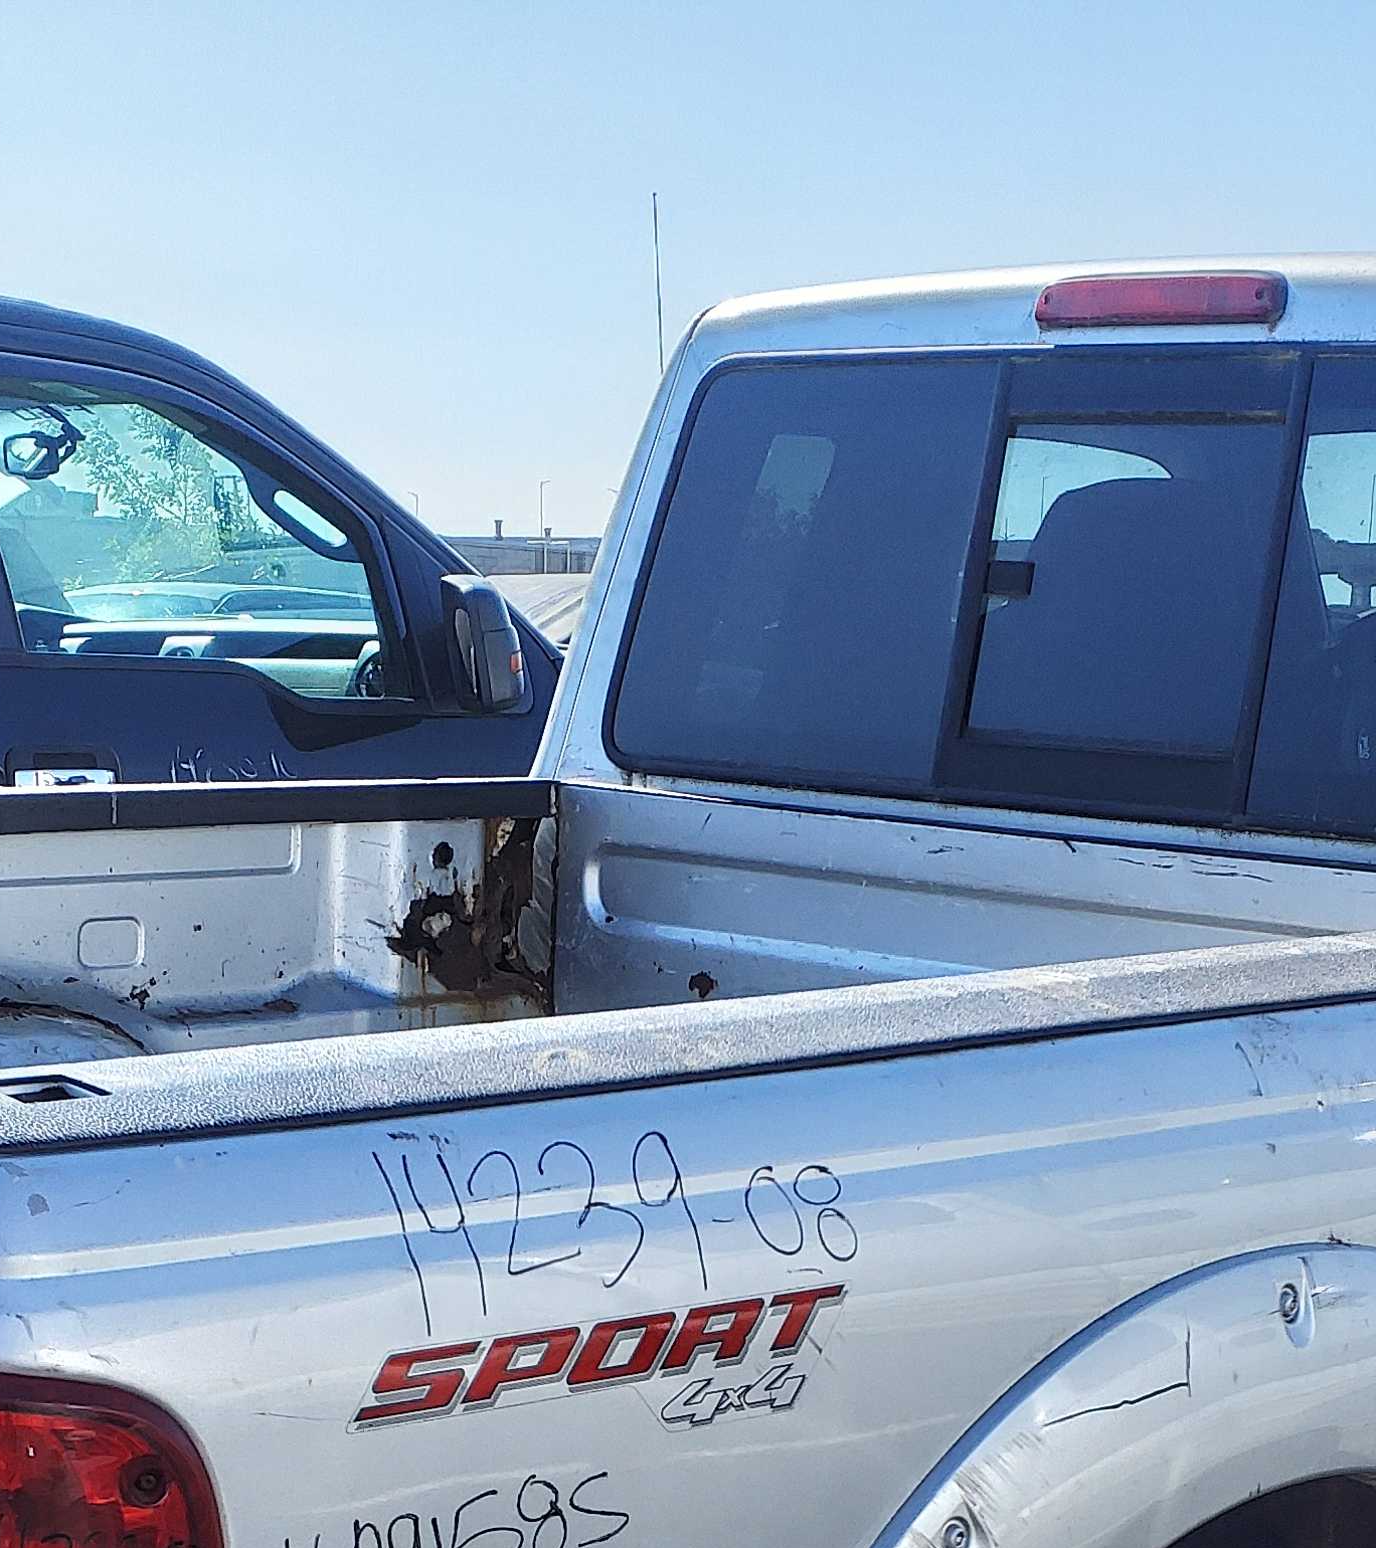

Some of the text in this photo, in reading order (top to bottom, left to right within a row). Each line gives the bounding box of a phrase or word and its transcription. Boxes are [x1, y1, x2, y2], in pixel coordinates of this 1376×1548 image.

[371, 1130, 859, 1337] 14239-08
[351, 1283, 849, 1432] SPORT
[659, 1362, 808, 1427] 4x4
